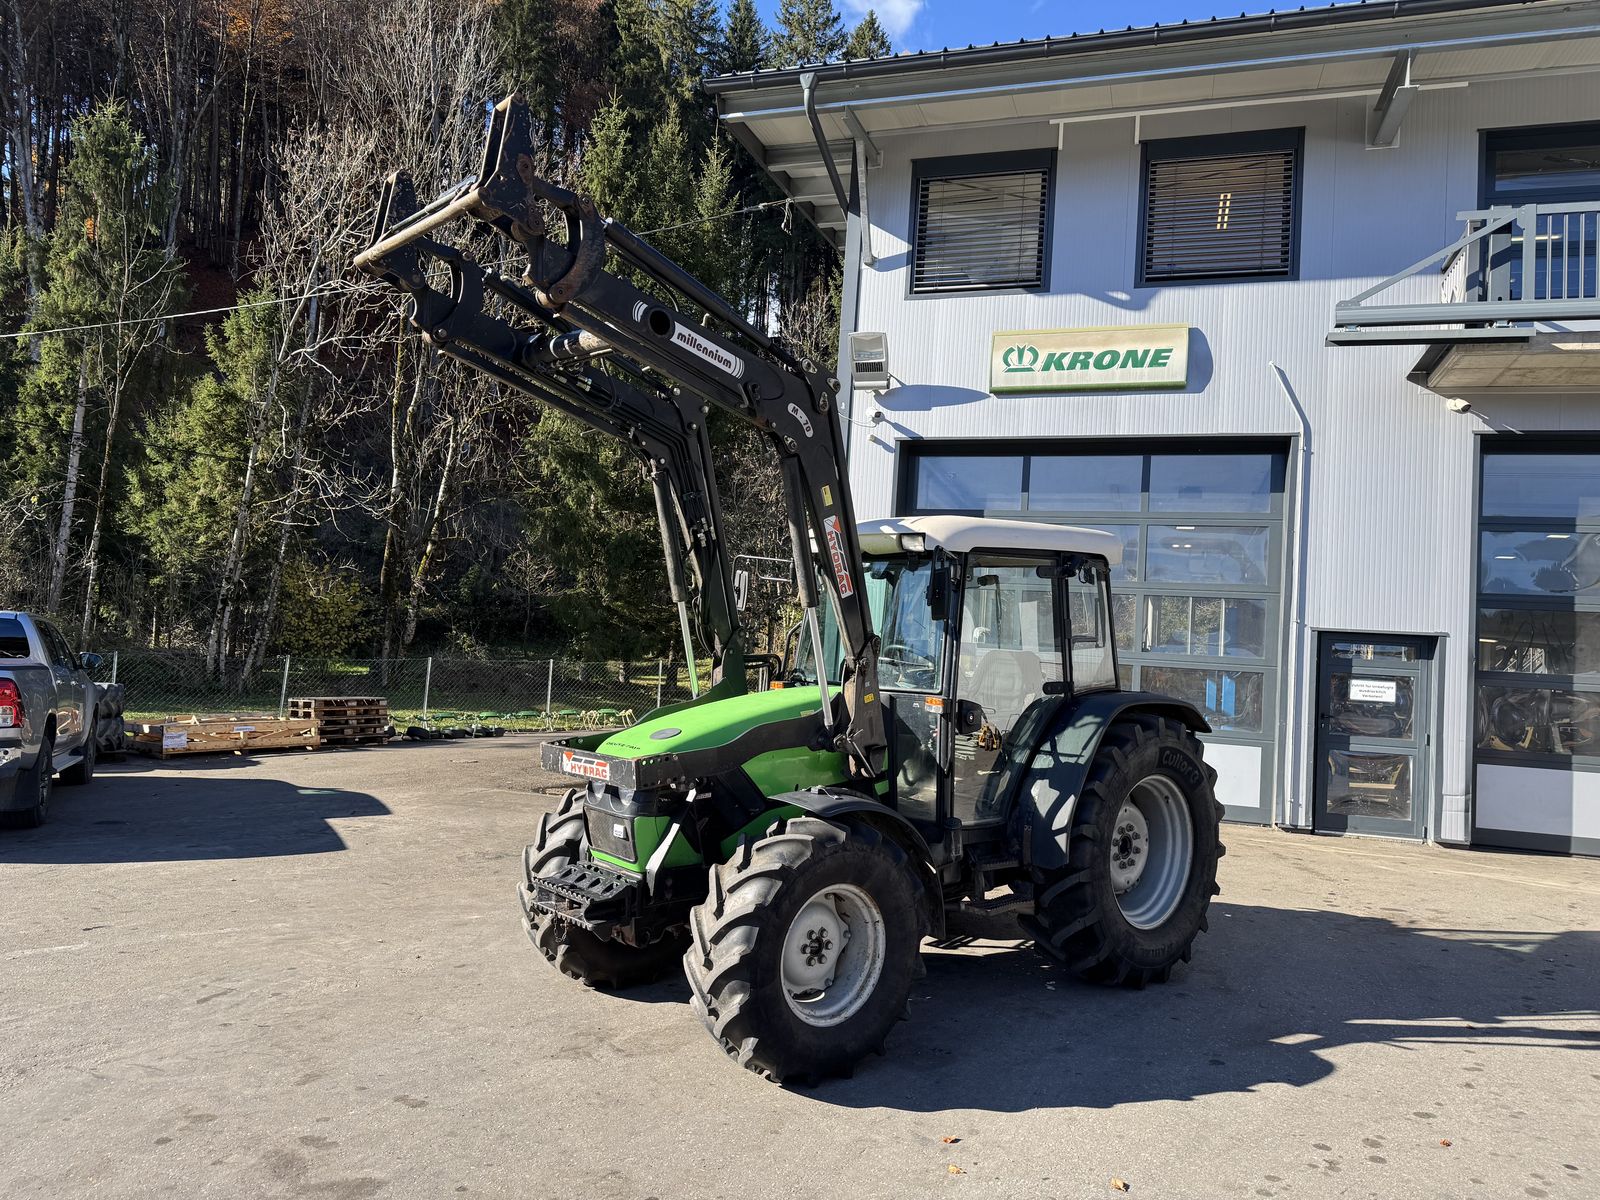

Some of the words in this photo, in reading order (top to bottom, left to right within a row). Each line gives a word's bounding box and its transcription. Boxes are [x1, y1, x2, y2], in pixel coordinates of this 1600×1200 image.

[677, 331, 732, 369] millennium
[1041, 347, 1174, 372] KRONE
[827, 530, 848, 594] HYDRAC
[570, 762, 608, 779] HYDRAC
